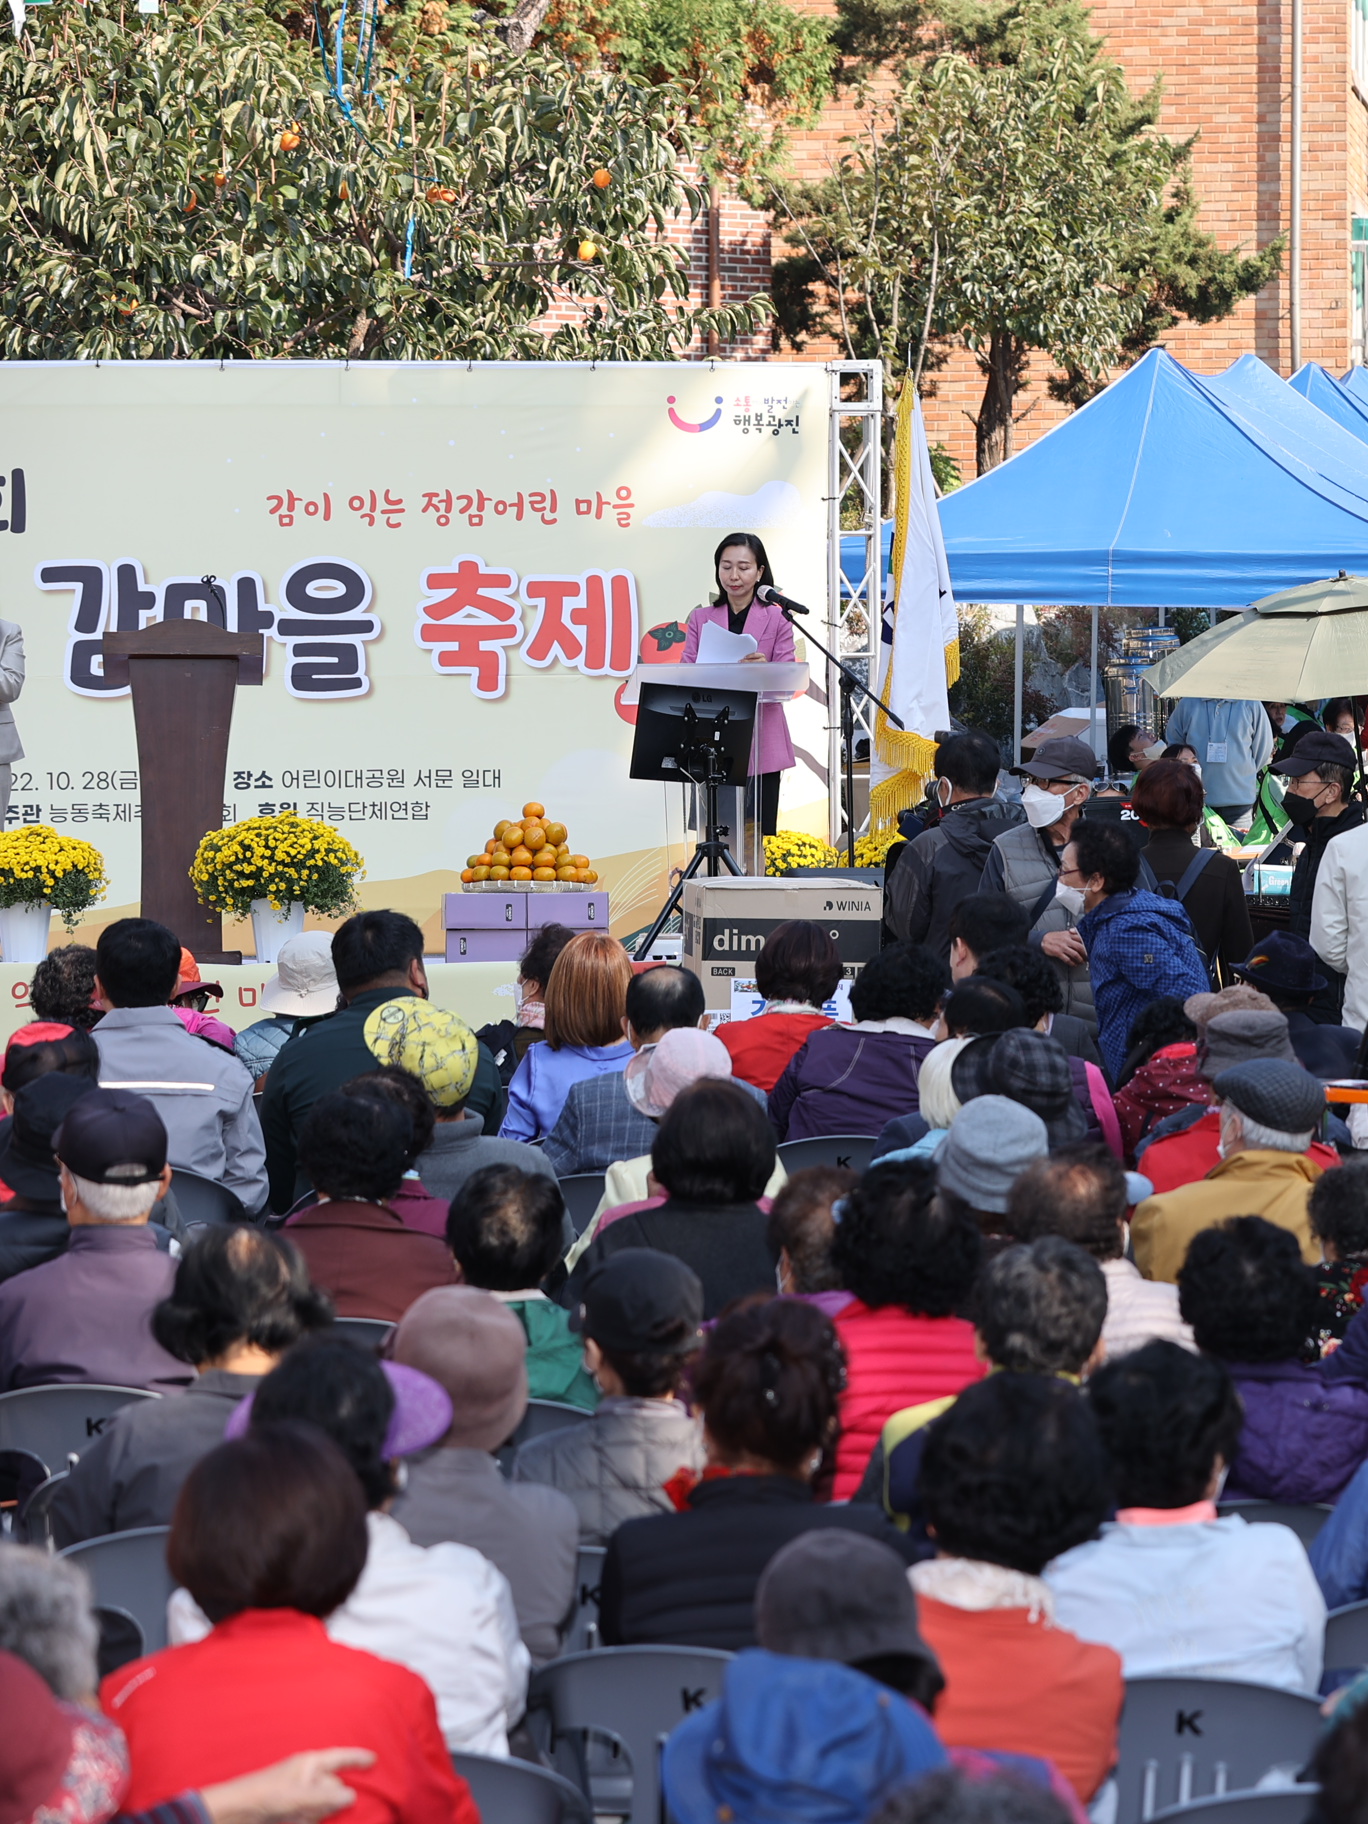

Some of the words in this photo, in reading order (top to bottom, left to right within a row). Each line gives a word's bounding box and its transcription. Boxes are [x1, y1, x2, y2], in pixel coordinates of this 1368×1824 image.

[733, 413, 800, 436] 행복광진
[266, 489, 331, 527] 감이
[348, 489, 405, 528] 익는
[421, 489, 558, 527] 정감어린
[576, 486, 634, 528] 마을
[421, 560, 631, 692] 축제
[702, 695, 712, 703] LG
[46, 771, 74, 790] 10.
[233, 770, 273, 790] 장소
[282, 769, 405, 790] 어린이대공원
[413, 769, 453, 788] 서문
[461, 769, 501, 788] 일대
[306, 801, 430, 821] 직능단체연합
[836, 900, 871, 912] WINIA
[713, 929, 766, 951] dim
[712, 967, 734, 976] BACK
[837, 1156, 851, 1169] K
[86, 1417, 106, 1437] K
[581, 1583, 601, 1606] K
[682, 1687, 706, 1712] K
[1176, 1709, 1204, 1737] K
